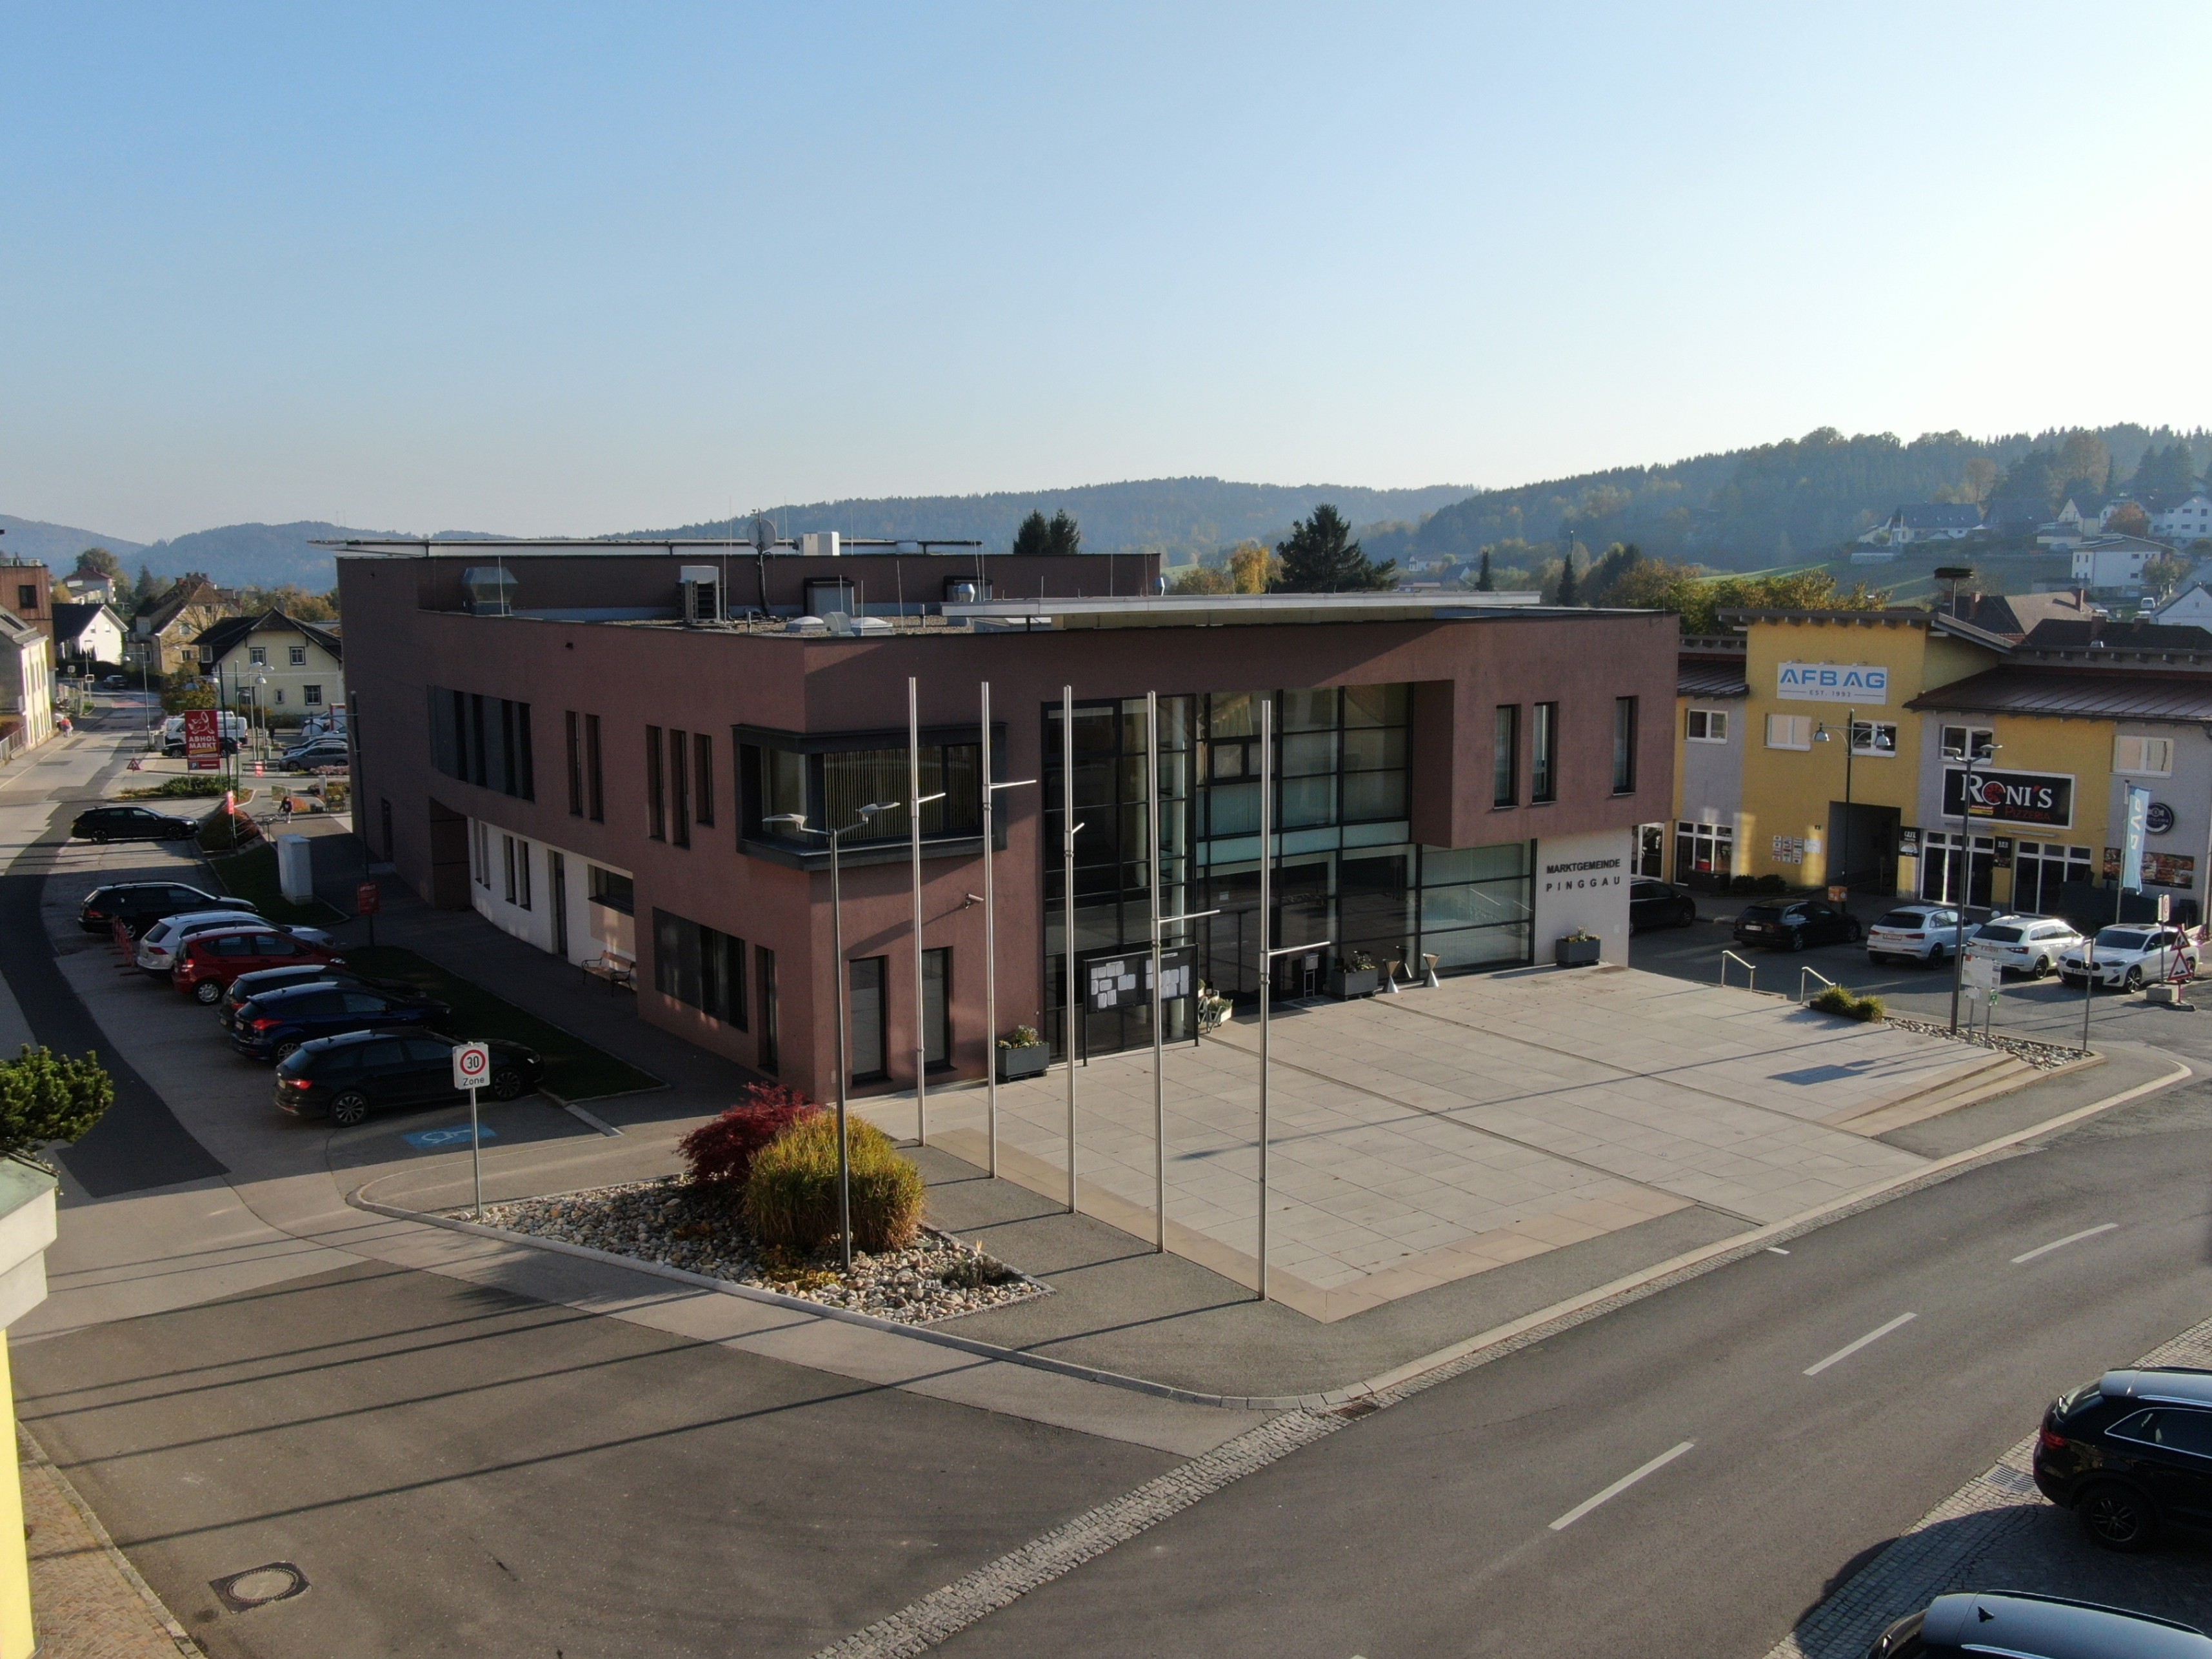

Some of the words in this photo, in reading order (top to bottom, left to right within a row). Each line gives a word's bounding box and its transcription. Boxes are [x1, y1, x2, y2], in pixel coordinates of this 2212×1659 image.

[2005, 806, 2051, 820] PIZZERIA
[1546, 858, 1620, 874] MARKTGEMEINDE
[1546, 876, 1620, 891] PINGGAU
[466, 1056, 479, 1069] 30
[463, 1077, 485, 1086] Zone
